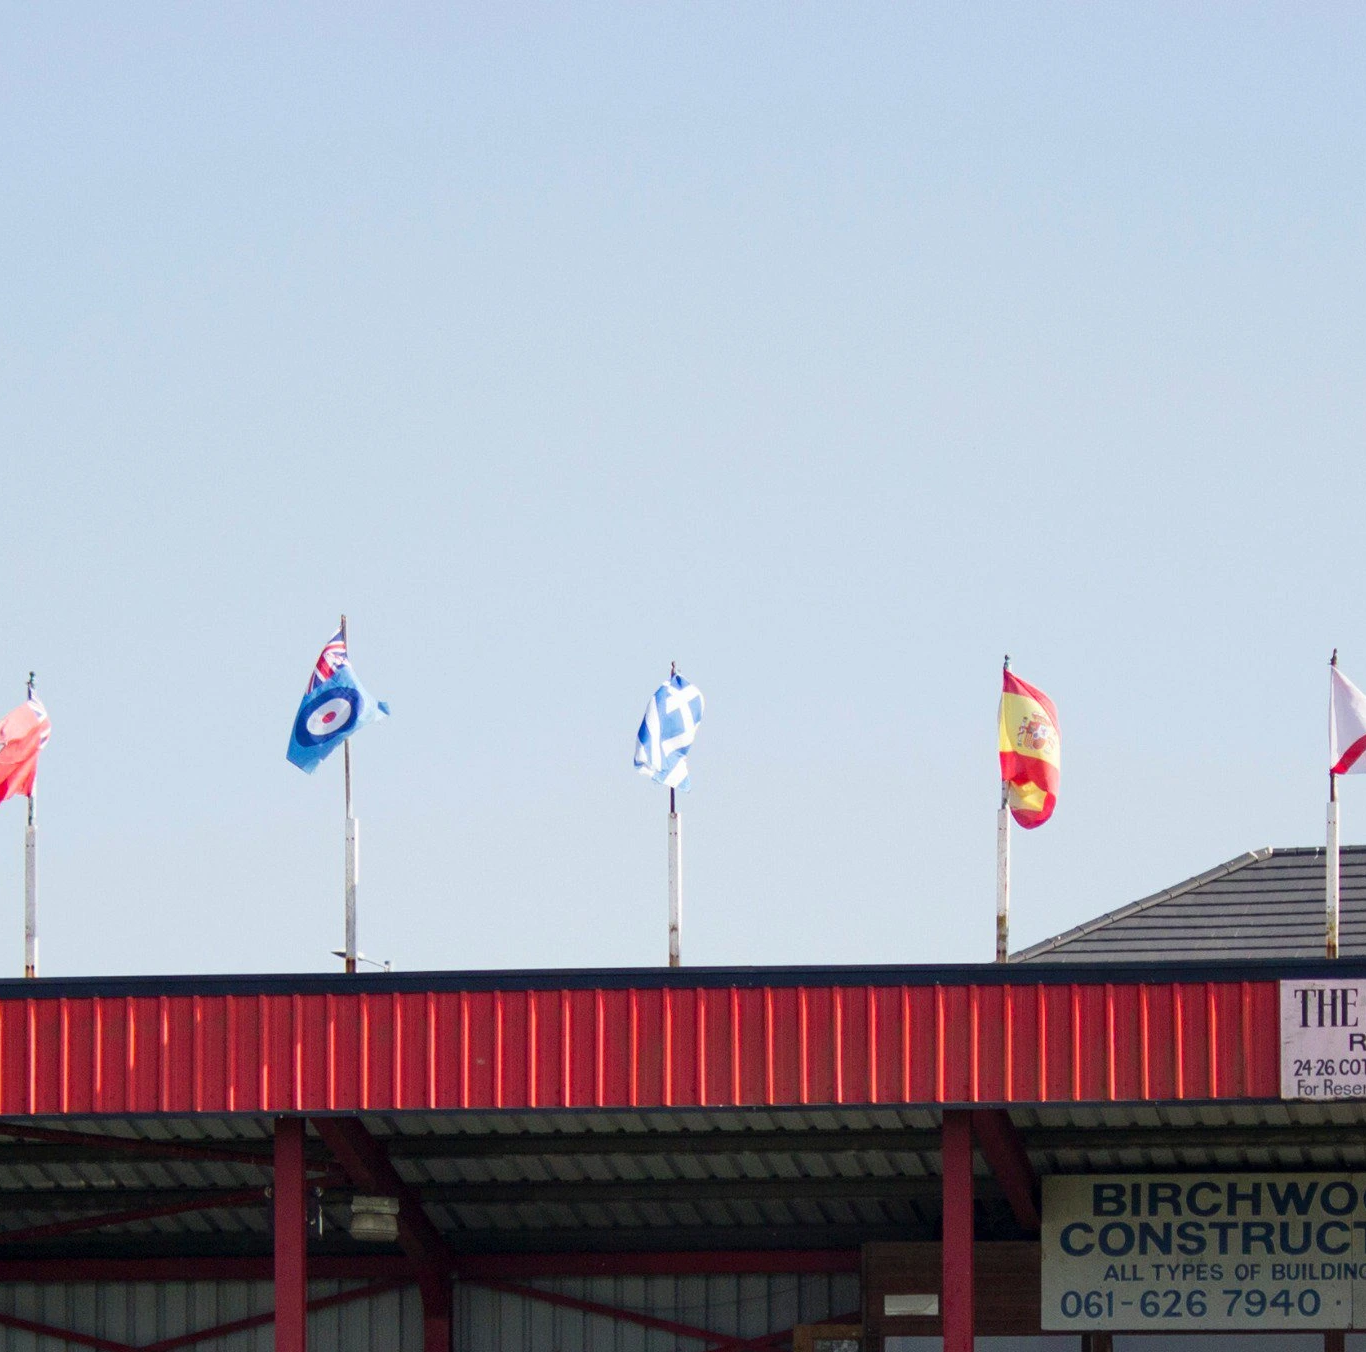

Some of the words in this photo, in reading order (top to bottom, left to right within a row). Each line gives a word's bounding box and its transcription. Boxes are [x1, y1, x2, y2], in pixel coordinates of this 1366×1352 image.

[1294, 987, 1358, 1028] THE
[1297, 1080, 1319, 1096] For
[1103, 1264, 1144, 1281] ALL
[1152, 1263, 1223, 1281] TYPES
[1235, 1263, 1261, 1281] OF
[1060, 1290, 1208, 1318] 061-626
[1222, 1288, 1321, 1317] 7940
